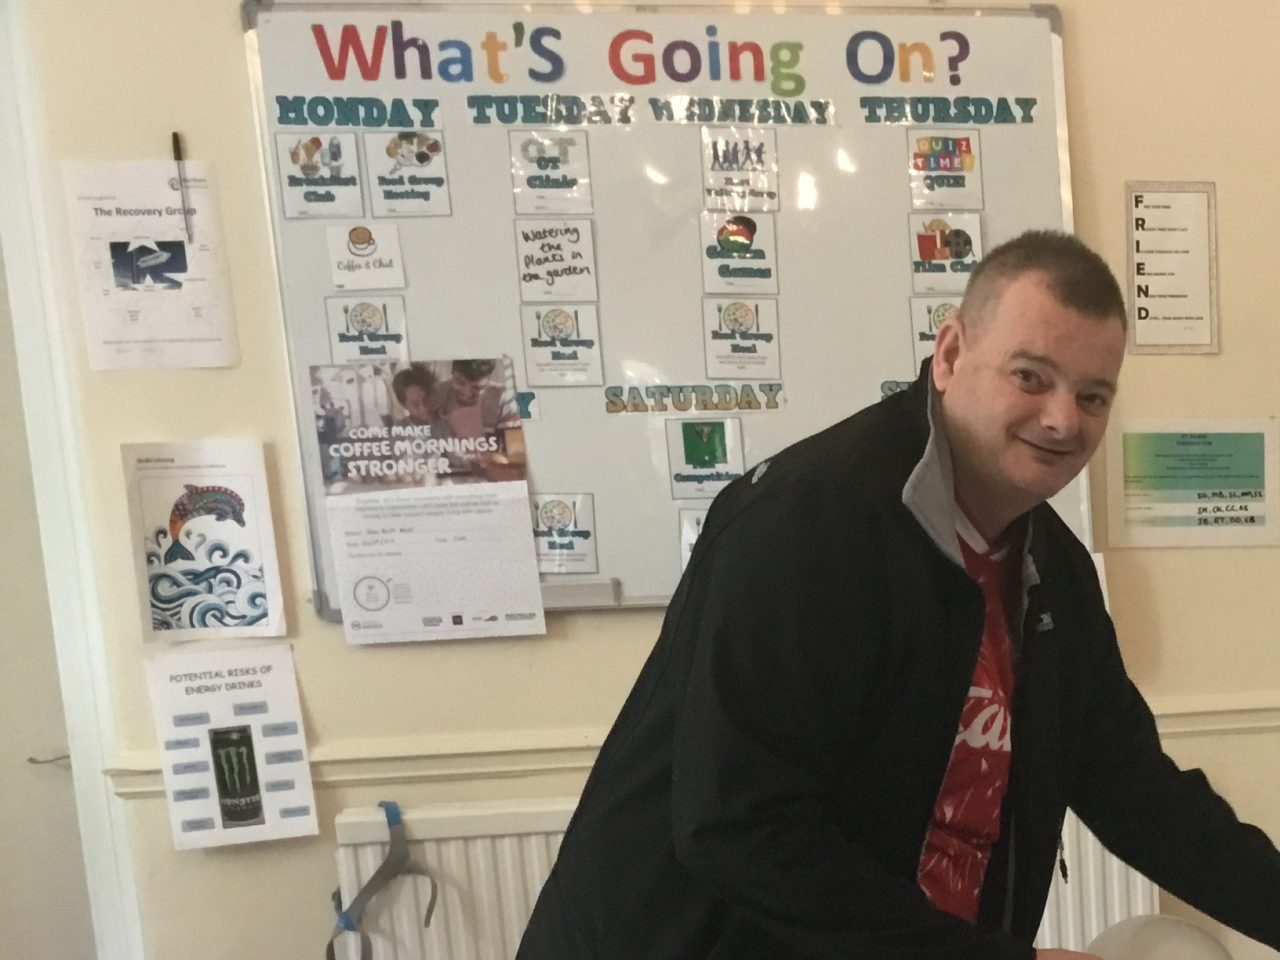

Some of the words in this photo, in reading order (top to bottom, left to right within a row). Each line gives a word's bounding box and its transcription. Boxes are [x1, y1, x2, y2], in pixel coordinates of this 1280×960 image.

[311, 20, 566, 84] What'S
[608, 25, 806, 98] Going
[846, 30, 971, 86] On?
[276, 95, 440, 127] MONDAY
[467, 95, 635, 125] TUESDAY
[860, 96, 1037, 124] THURSDAY
[92, 207, 112, 217] The
[115, 206, 162, 218] Recovery
[520, 224, 580, 244] Watering
[539, 242, 563, 254] the
[523, 253, 565, 270] Plants
[571, 250, 583, 260] in
[521, 272, 543, 283] the
[546, 265, 591, 286] garden
[605, 383, 783, 414] SATURDAY
[349, 427, 390, 440] COME
[391, 425, 432, 437] MAKE
[328, 439, 393, 458] COFFEE
[394, 435, 498, 457] MORNINGS
[347, 457, 453, 479] STRONGER
[169, 671, 226, 683] POTENTIAL
[227, 668, 258, 677] RISKS
[260, 664, 274, 675] OF
[184, 684, 222, 695] ENERGY
[225, 680, 263, 691] DRINKS
